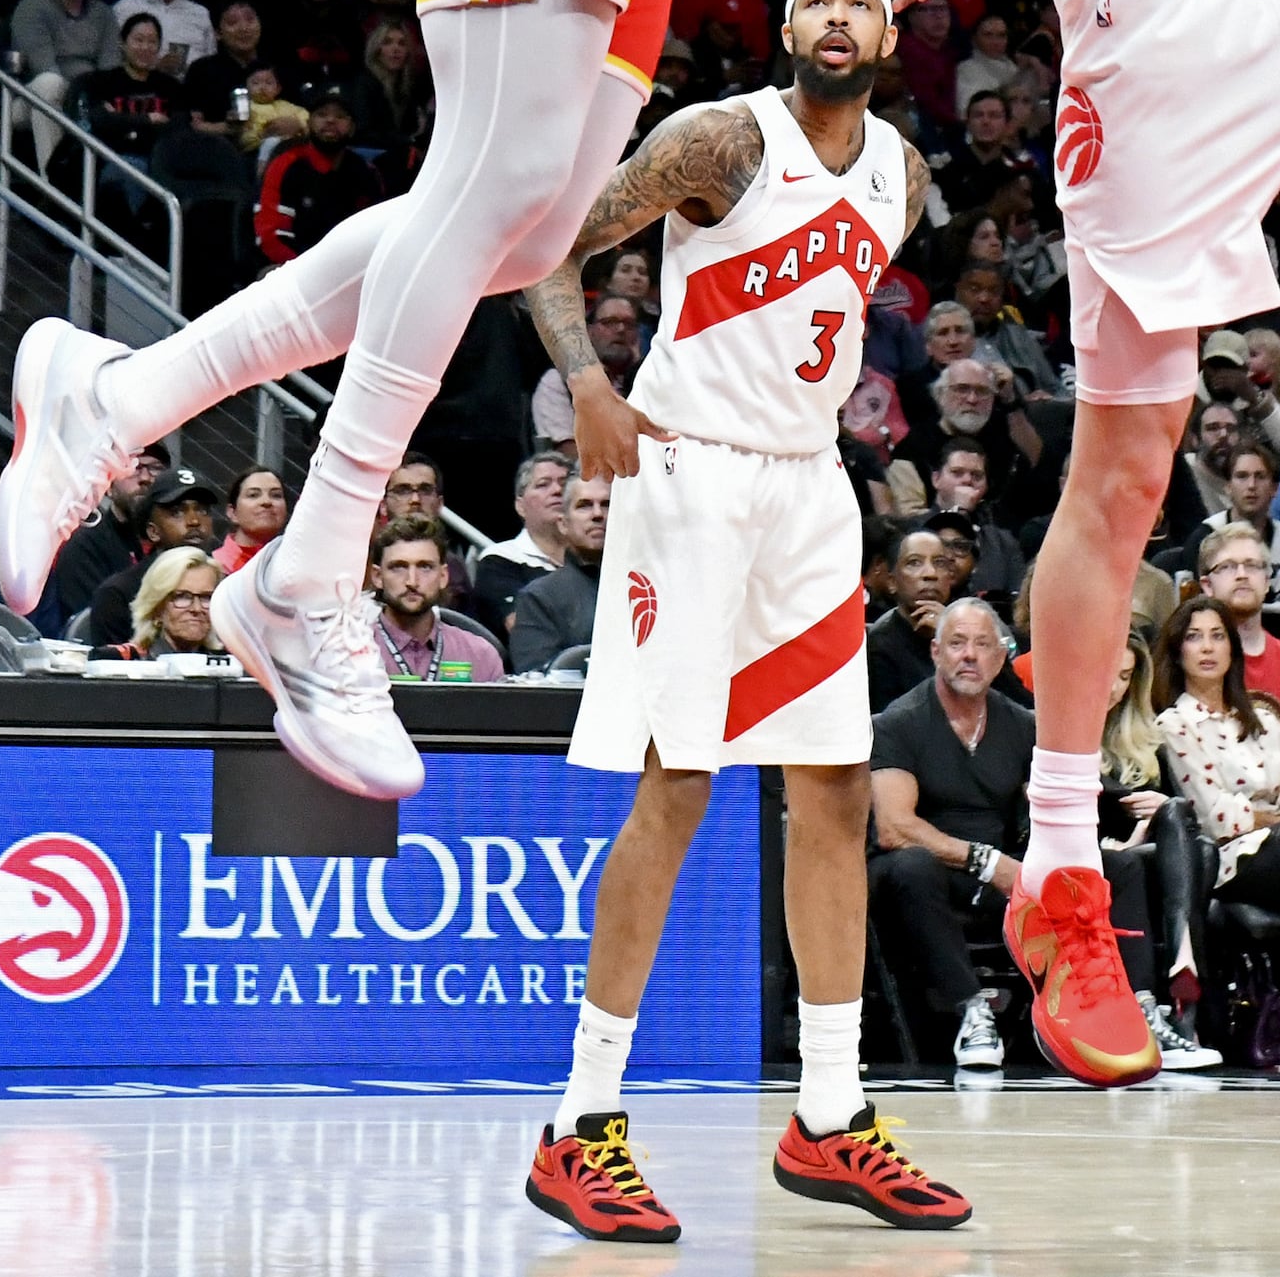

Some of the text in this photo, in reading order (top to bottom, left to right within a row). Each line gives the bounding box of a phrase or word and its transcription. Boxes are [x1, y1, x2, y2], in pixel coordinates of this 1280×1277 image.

[743, 220, 883, 298] RAPTOR
[795, 309, 846, 383] 3
[177, 469, 196, 485] 3
[179, 832, 609, 943] EMORY
[184, 963, 586, 1007] HEALTHCARE
